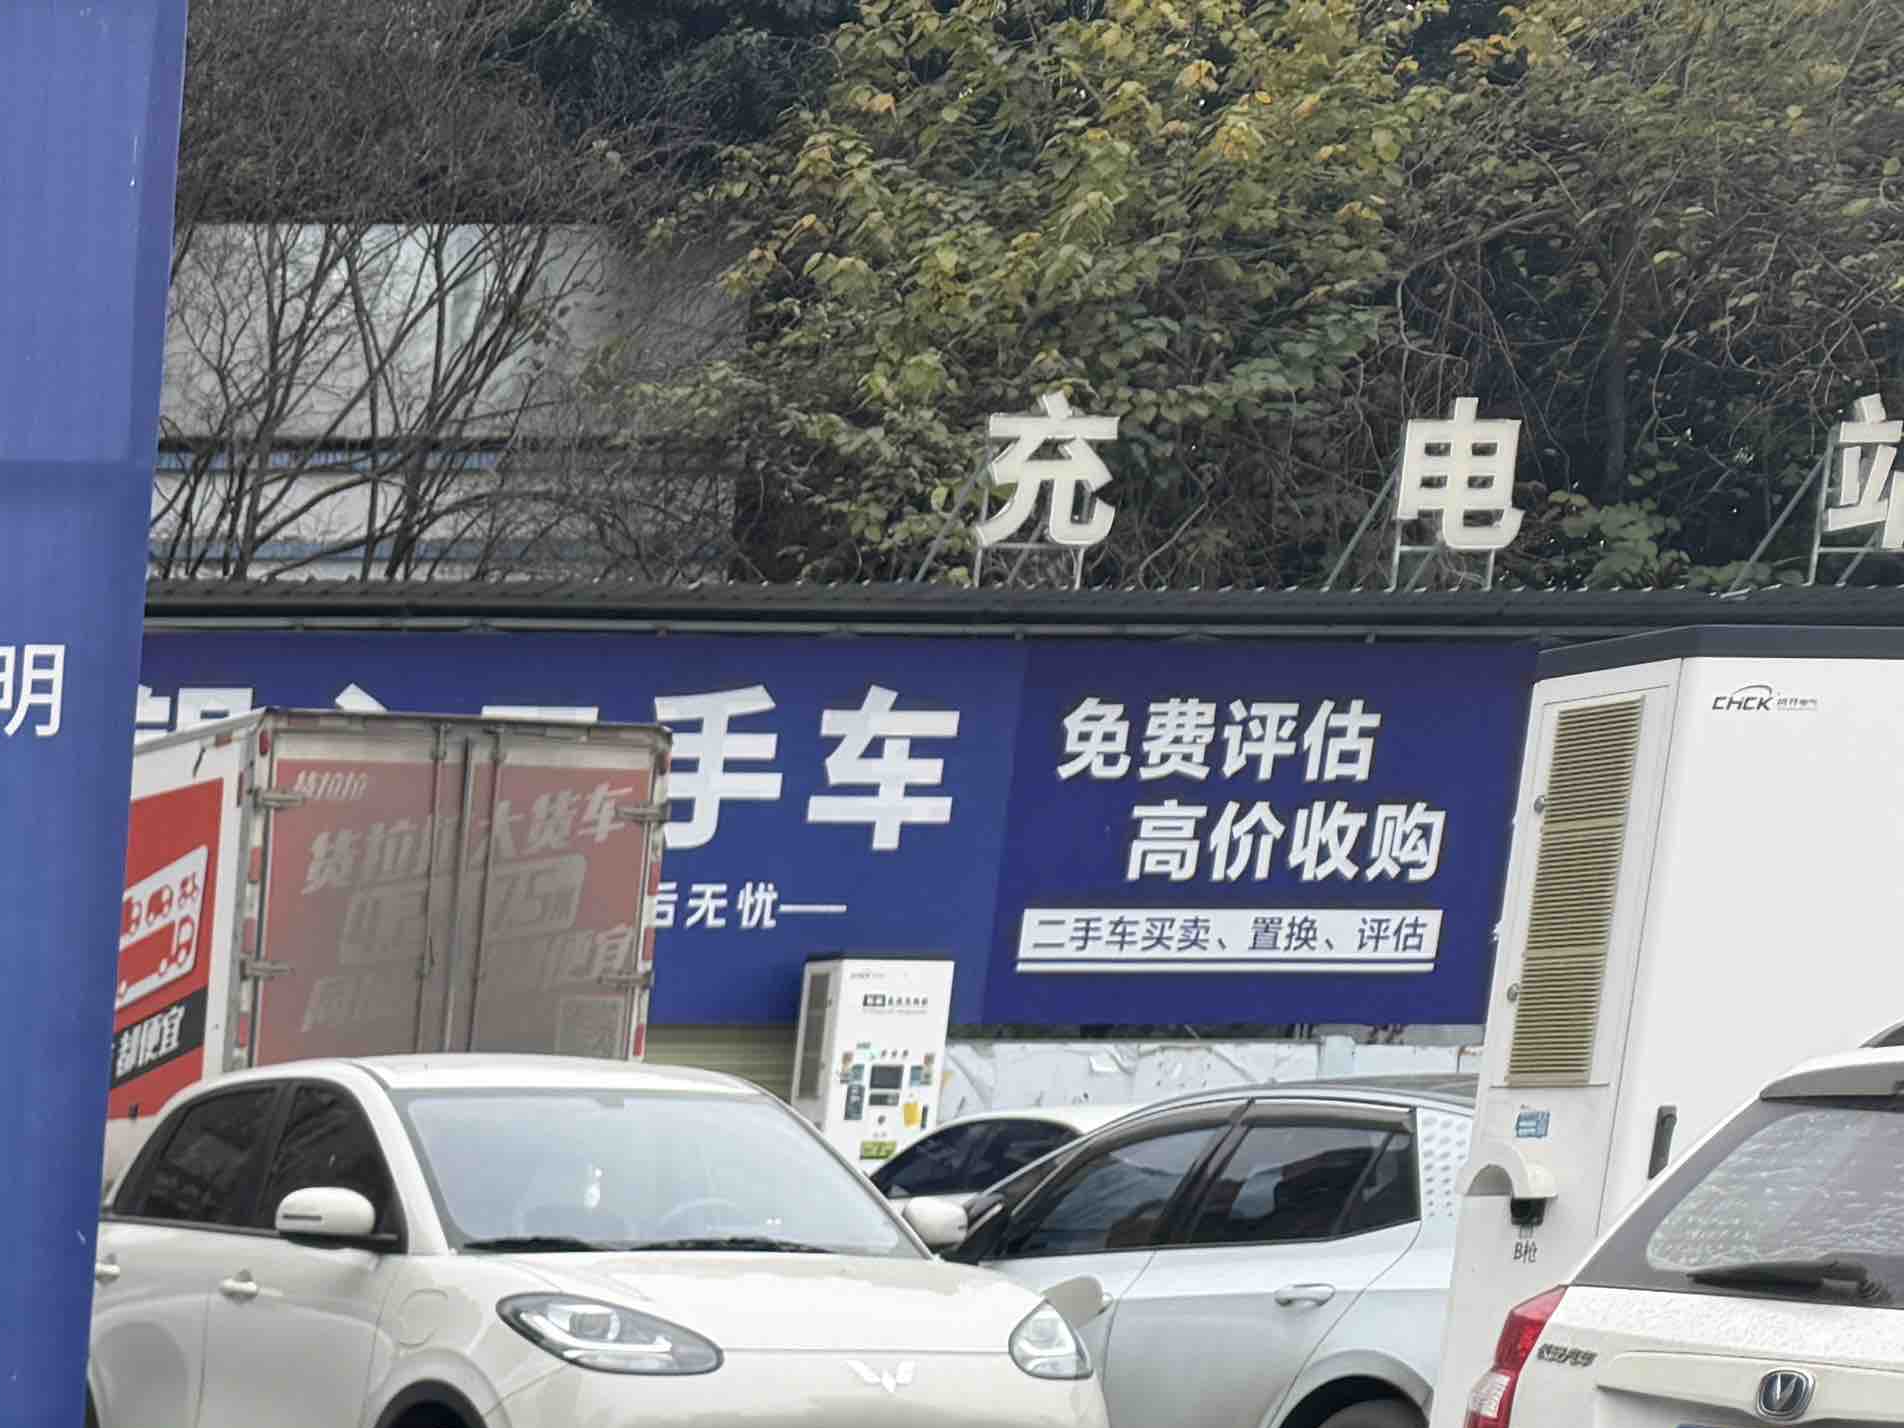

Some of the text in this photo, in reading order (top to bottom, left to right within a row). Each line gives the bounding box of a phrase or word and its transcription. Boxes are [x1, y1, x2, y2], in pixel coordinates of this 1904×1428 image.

[1057, 697, 1382, 781] 免费评估
[1127, 799, 1447, 882] 高价收购
[1032, 915, 1428, 953] 二手车买卖、置换、评估
